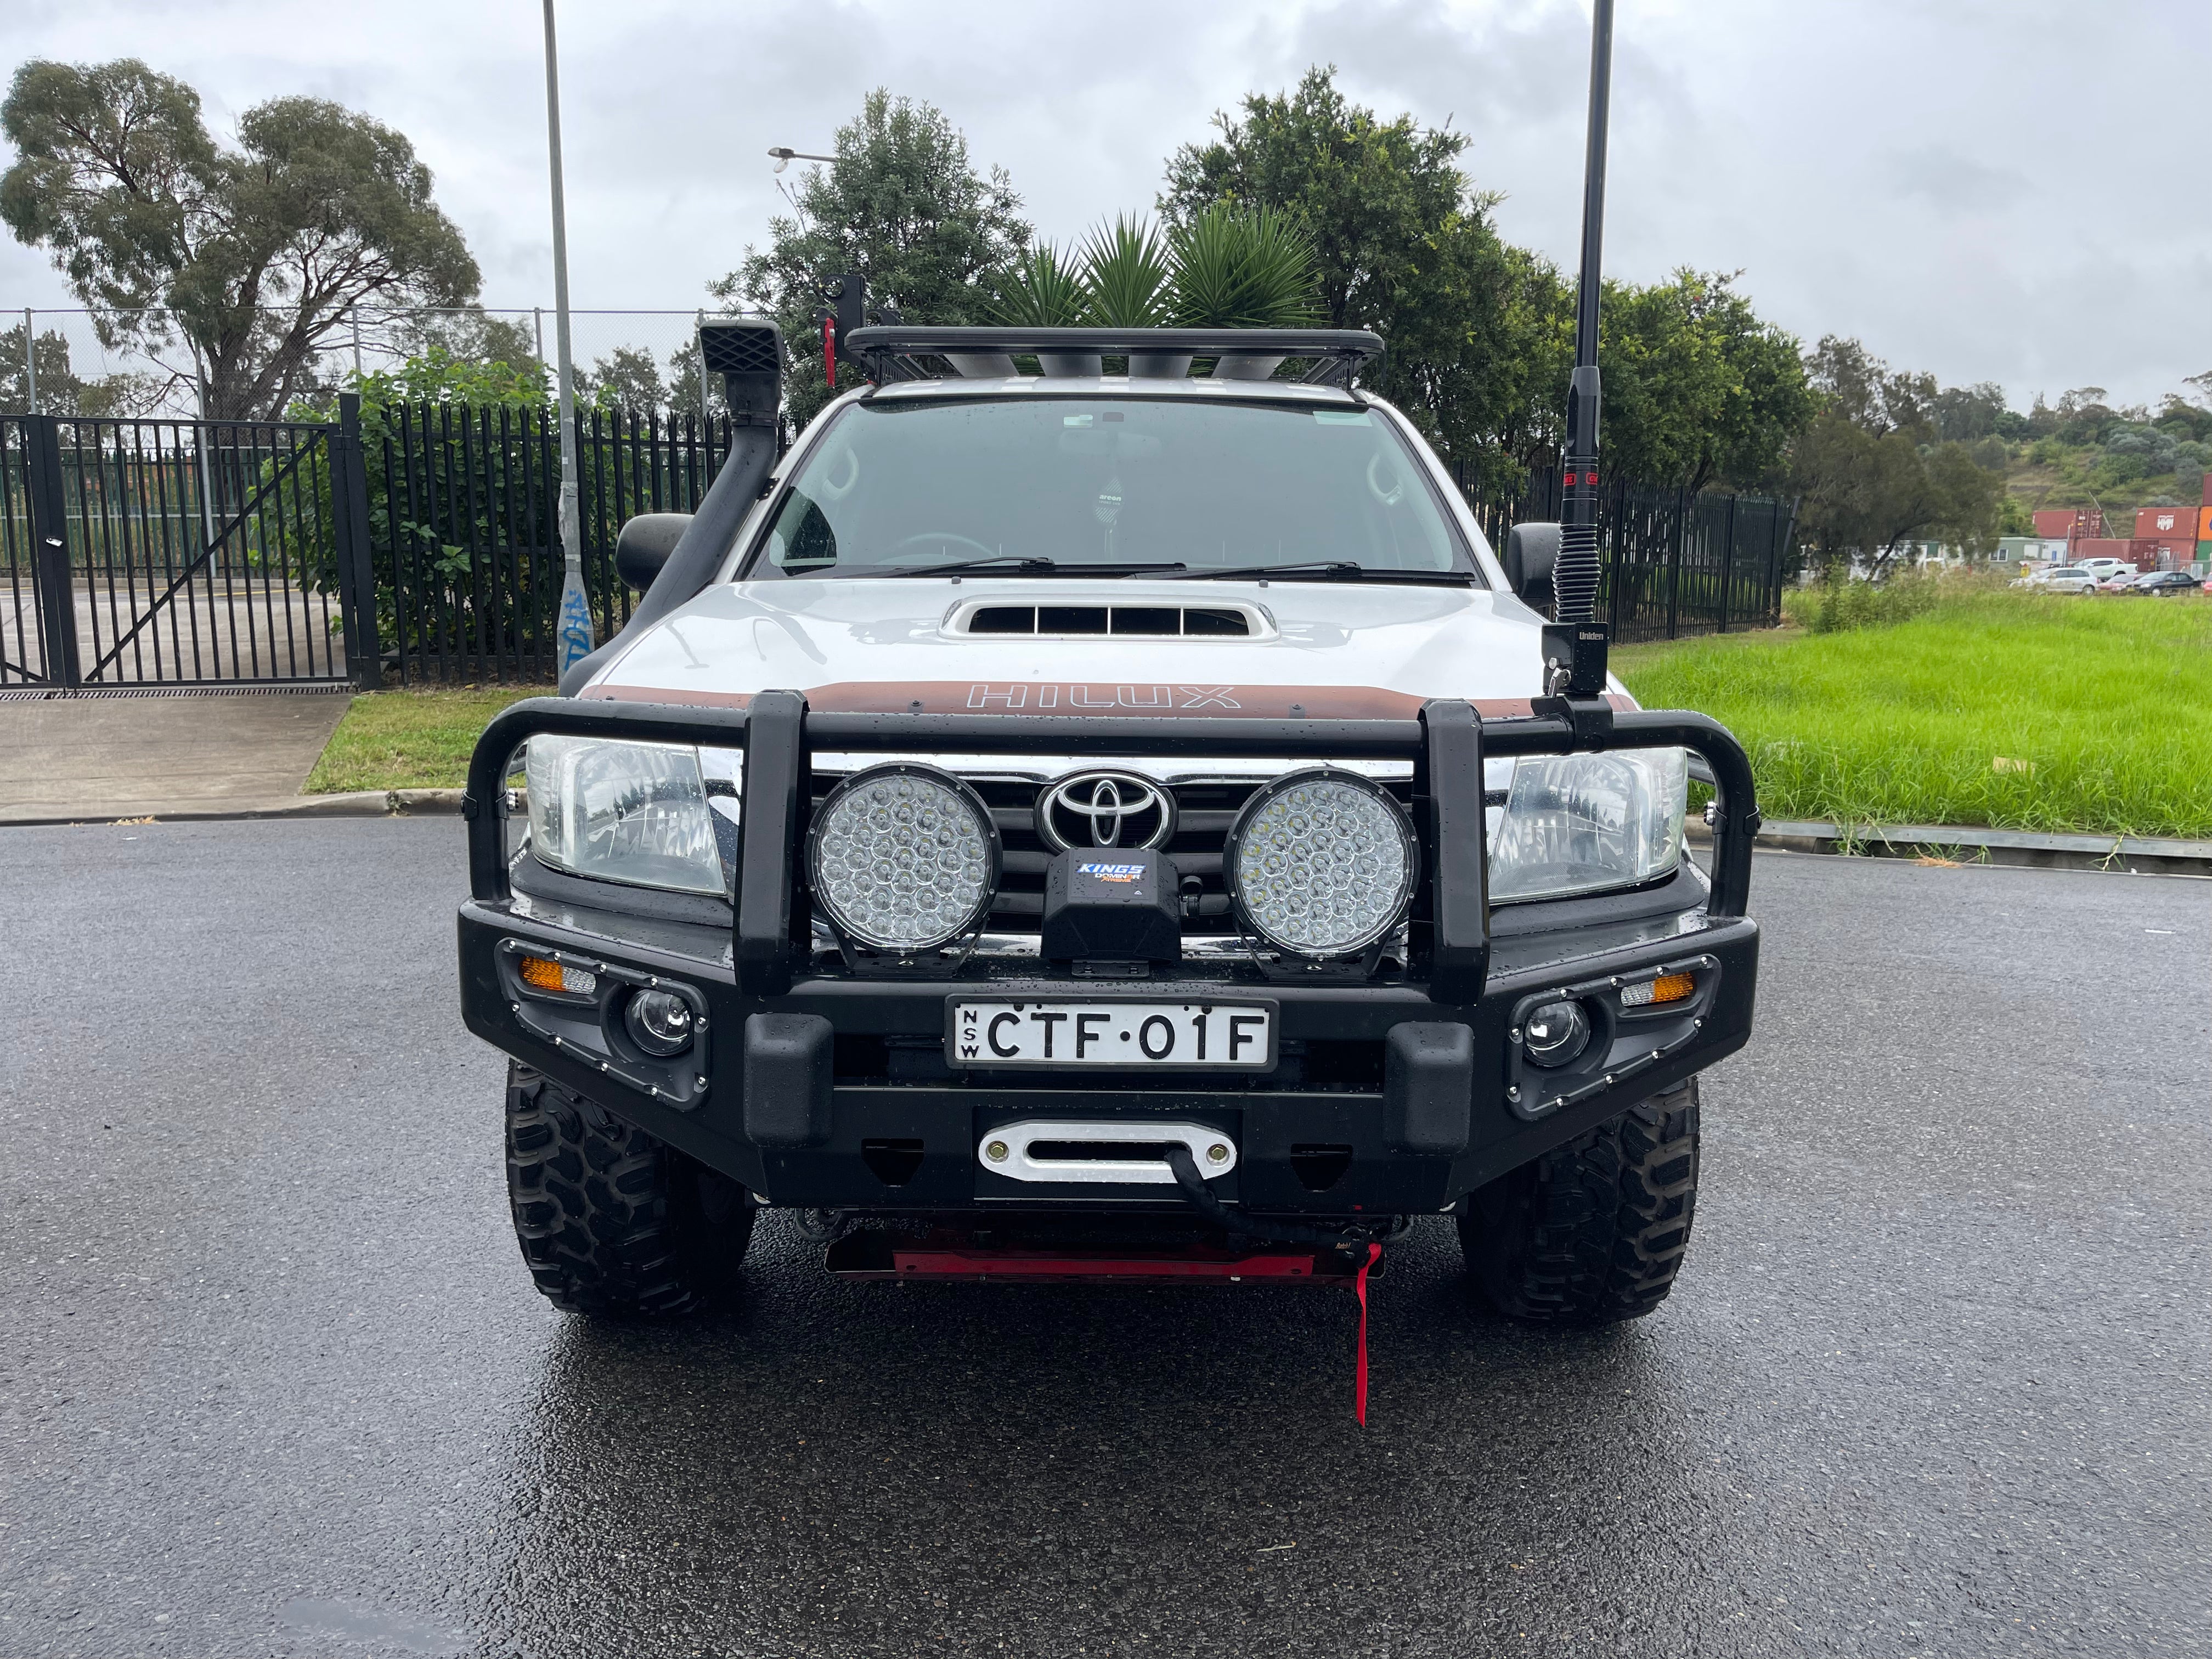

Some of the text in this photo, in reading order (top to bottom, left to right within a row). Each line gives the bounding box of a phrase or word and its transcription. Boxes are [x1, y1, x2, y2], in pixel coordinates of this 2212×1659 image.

[1579, 631, 1604, 640] Uniden
[966, 684, 1242, 709] HILUX
[1077, 863, 1146, 874] KINGS
